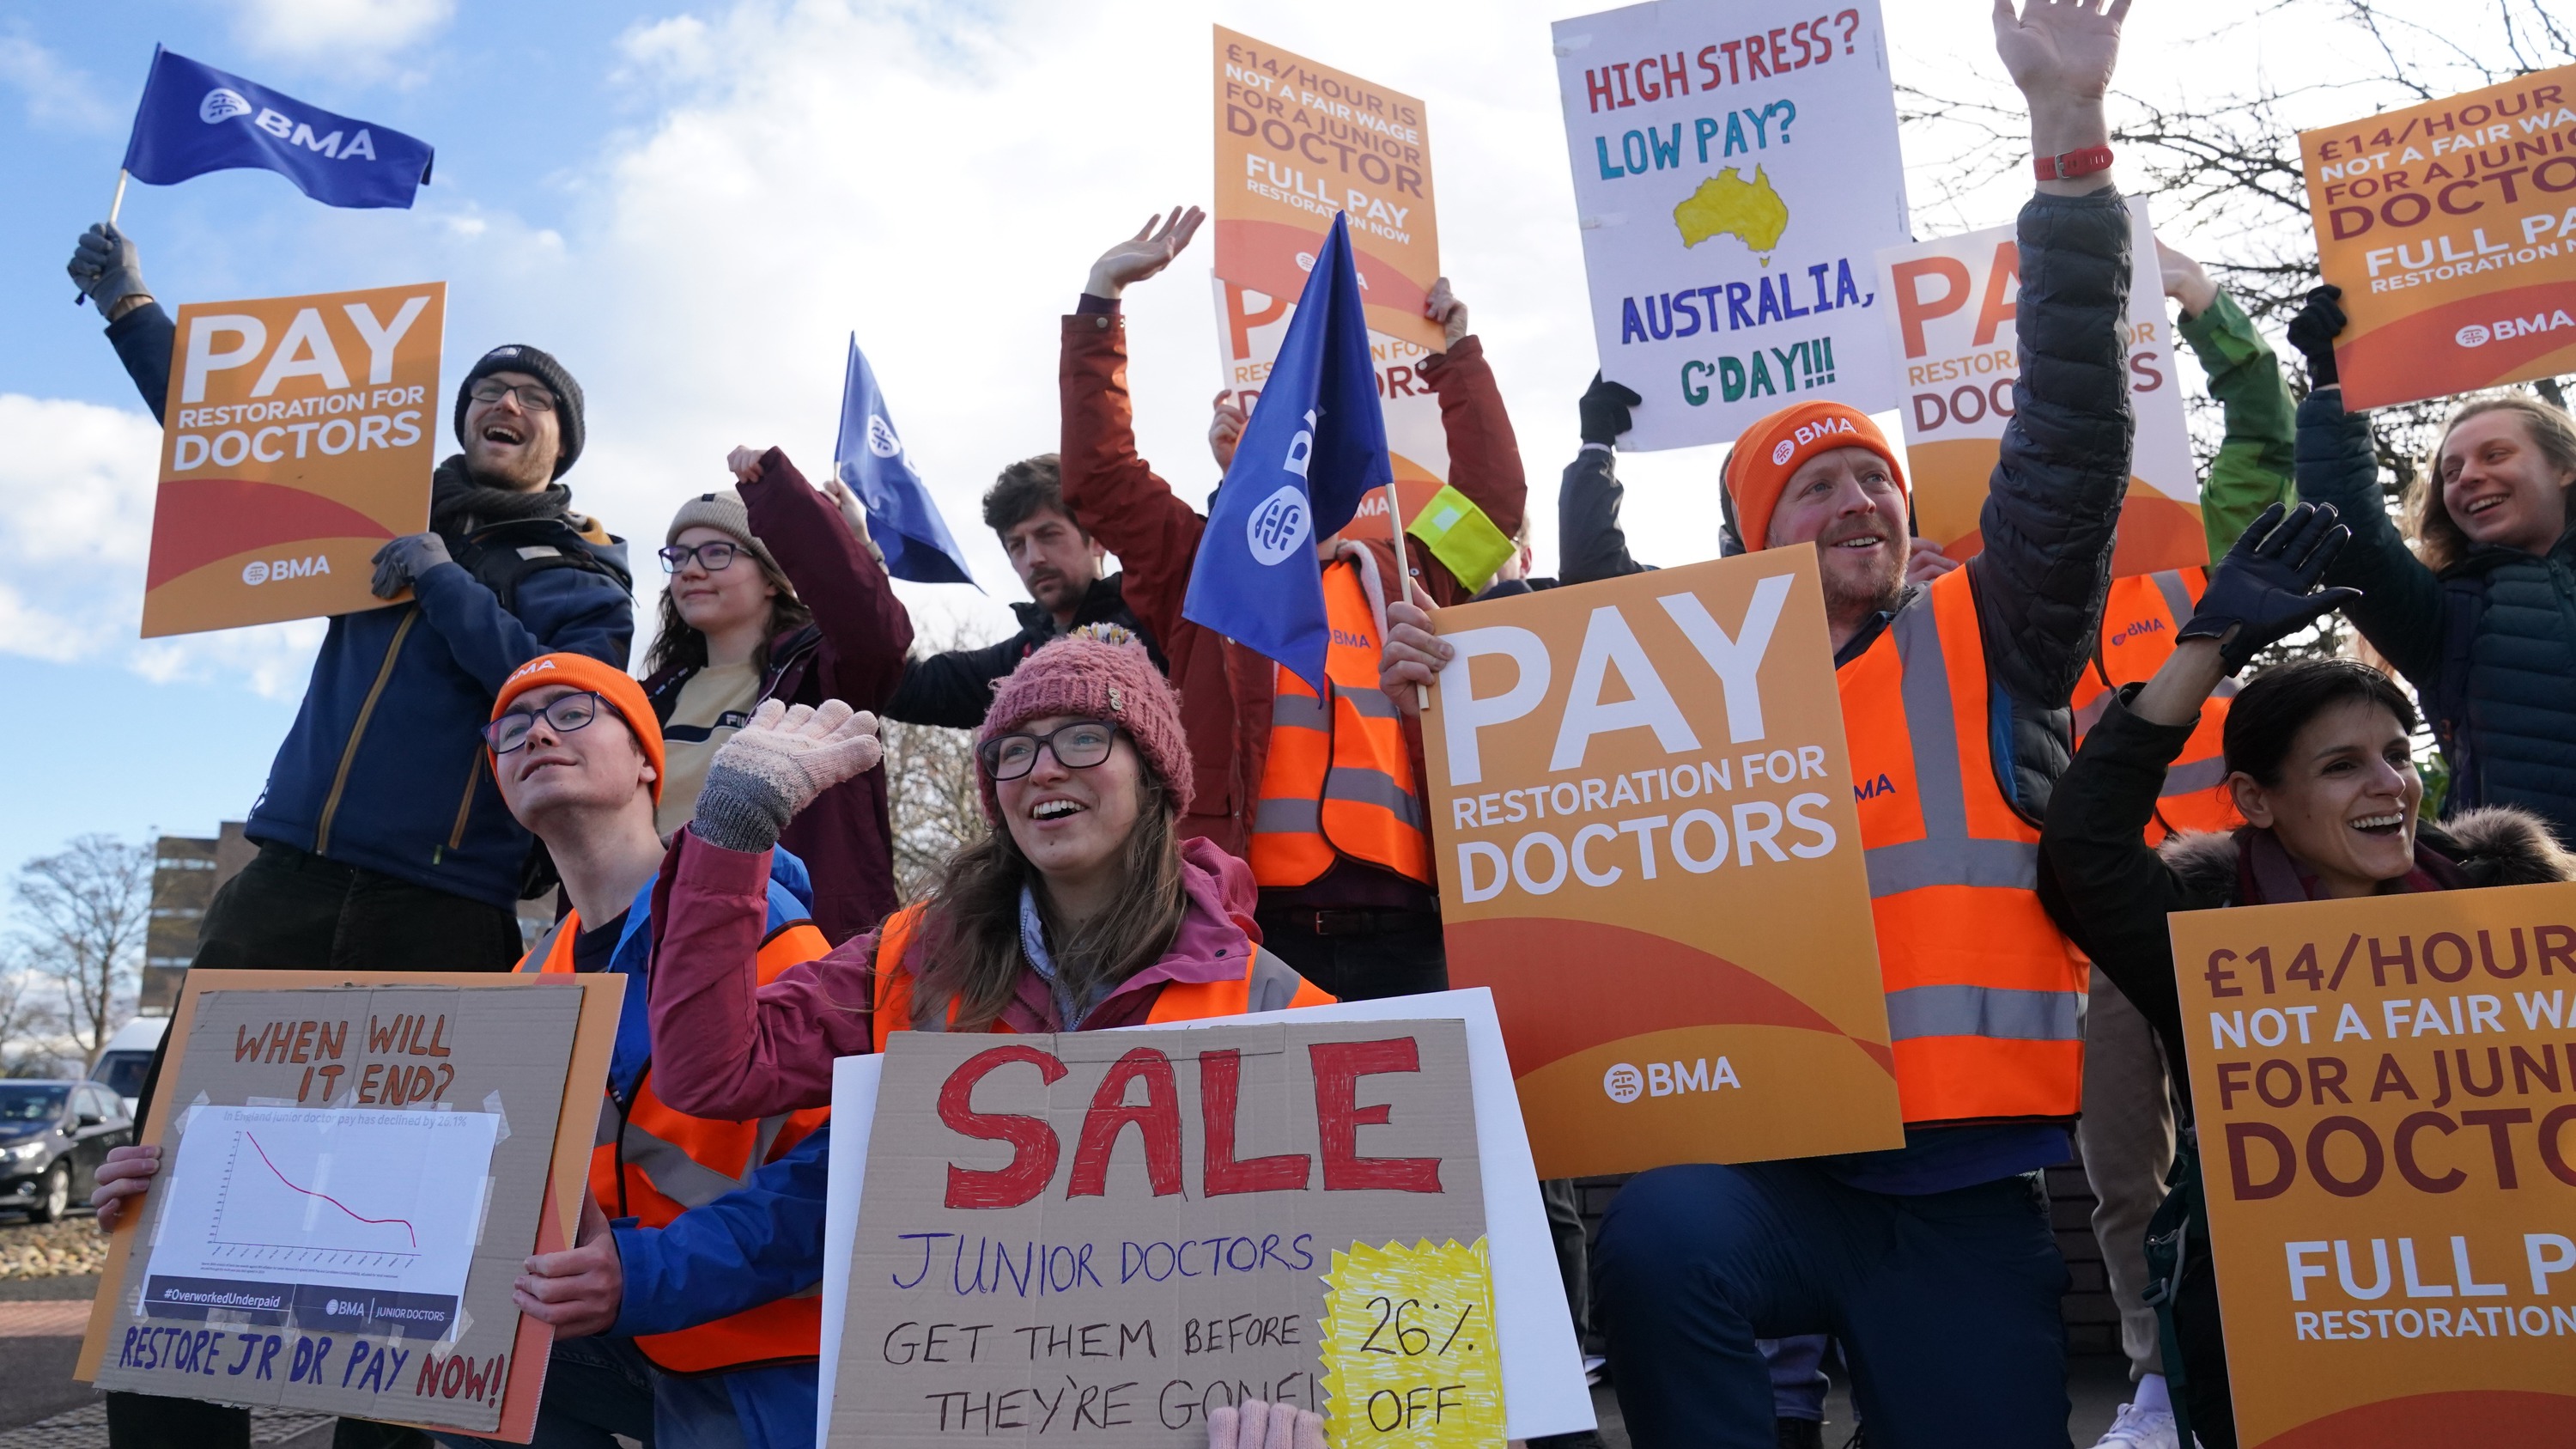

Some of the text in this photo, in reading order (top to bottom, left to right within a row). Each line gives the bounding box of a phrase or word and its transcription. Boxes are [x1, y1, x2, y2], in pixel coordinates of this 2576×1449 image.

[1226, 44, 1417, 126] £14/HOUR IS
[1585, 52, 1690, 114] HIGH
[1697, 9, 1860, 92] STRESS?
[254, 107, 377, 161] BMA
[1225, 64, 1419, 145] NOT A FAIR WAGE
[1226, 82, 1421, 167] FOR A JUNIOR
[2318, 85, 2565, 161] £14/HOUR
[1226, 103, 1424, 199] DOCTOR
[1595, 99, 1796, 180] LOW PAY?
[2321, 151, 2390, 182] NOT
[2400, 146, 2424, 165] A
[2432, 123, 2512, 157] FAIR
[2325, 127, 2576, 205] FOR A JUNI
[1246, 153, 1409, 229] FULL PAY
[1246, 179, 1410, 245] RESTORATON NOW
[2366, 228, 2509, 277] FULL
[2371, 242, 2559, 294] RESTORATION
[1621, 258, 1874, 345] AUSTRALIA,
[2493, 309, 2576, 341] BMA
[181, 295, 431, 404] PAY
[179, 386, 425, 429] RESTORATION FOR
[1795, 417, 1858, 445] BMA
[173, 411, 422, 472] DOCTORS
[1354, 496, 1390, 519] MA
[271, 556, 331, 582] BMA
[1334, 630, 1371, 648] BMA
[1437, 572, 1795, 786] PAY
[1452, 745, 1827, 830] RESTORATION FOR
[1854, 773, 1896, 804] MA
[1457, 792, 1837, 904] DOCTORS
[2204, 924, 2576, 999] £14/HOUR
[234, 1014, 452, 1064] WHEN WILL
[2208, 1005, 2317, 1050] NOT
[2333, 1003, 2372, 1042] A
[2382, 994, 2506, 1038] FAIR
[297, 1062, 456, 1108] IT END?
[1648, 1056, 1741, 1098] BMA
[2216, 1056, 2352, 1111] FOR
[2370, 1052, 2419, 1103] A
[234, 1111, 272, 1123] England
[272, 1111, 302, 1123] junior
[303, 1112, 337, 1123] doctor
[337, 1115, 355, 1127] pay
[357, 1114, 375, 1125] has
[378, 1115, 420, 1126] declined
[422, 1116, 436, 1129] by
[936, 1036, 1444, 1209] SALE
[892, 1233, 1315, 1297] JUNIOR DOCTORS
[2285, 1235, 2507, 1302] FULL
[163, 1288, 281, 1309] #OverworkedUnderpaid
[338, 1301, 364, 1316] BMA
[375, 1306, 445, 1321] JUNIOR DOCTORS
[1359, 1295, 1475, 1359] 26%
[2294, 1305, 2576, 1342] RESTORATION
[118, 1325, 505, 1409] RESTORE JR DR PAY NOW!
[883, 1314, 1300, 1366] GET THEM BEFORE
[1366, 1384, 1467, 1433] OFF
